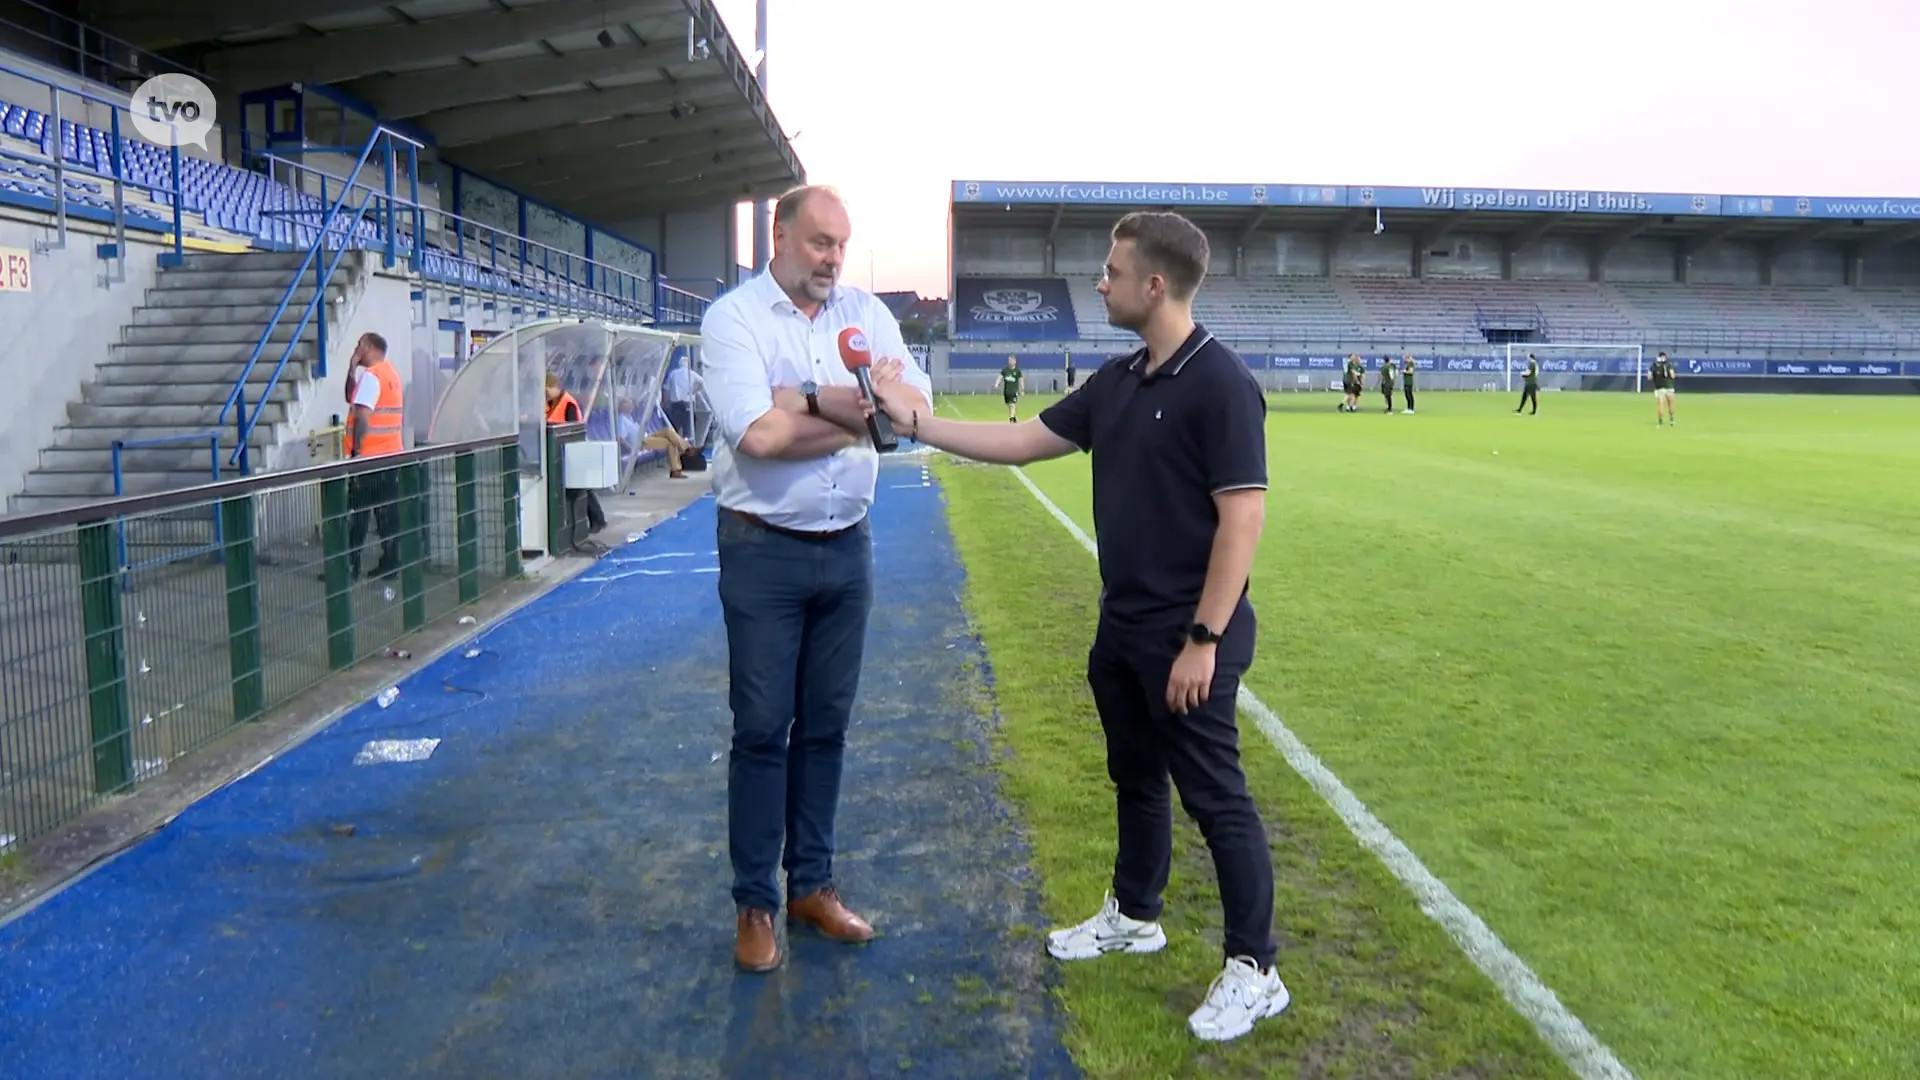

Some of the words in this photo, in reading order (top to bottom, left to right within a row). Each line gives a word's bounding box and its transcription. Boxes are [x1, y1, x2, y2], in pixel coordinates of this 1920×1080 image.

[997, 185, 1228, 200] www.fcvdendereh.be
[1421, 188, 1455, 208] Wij
[1463, 190, 1528, 208] spelen
[1537, 191, 1589, 212] altijd
[1598, 192, 1653, 210] thuis.
